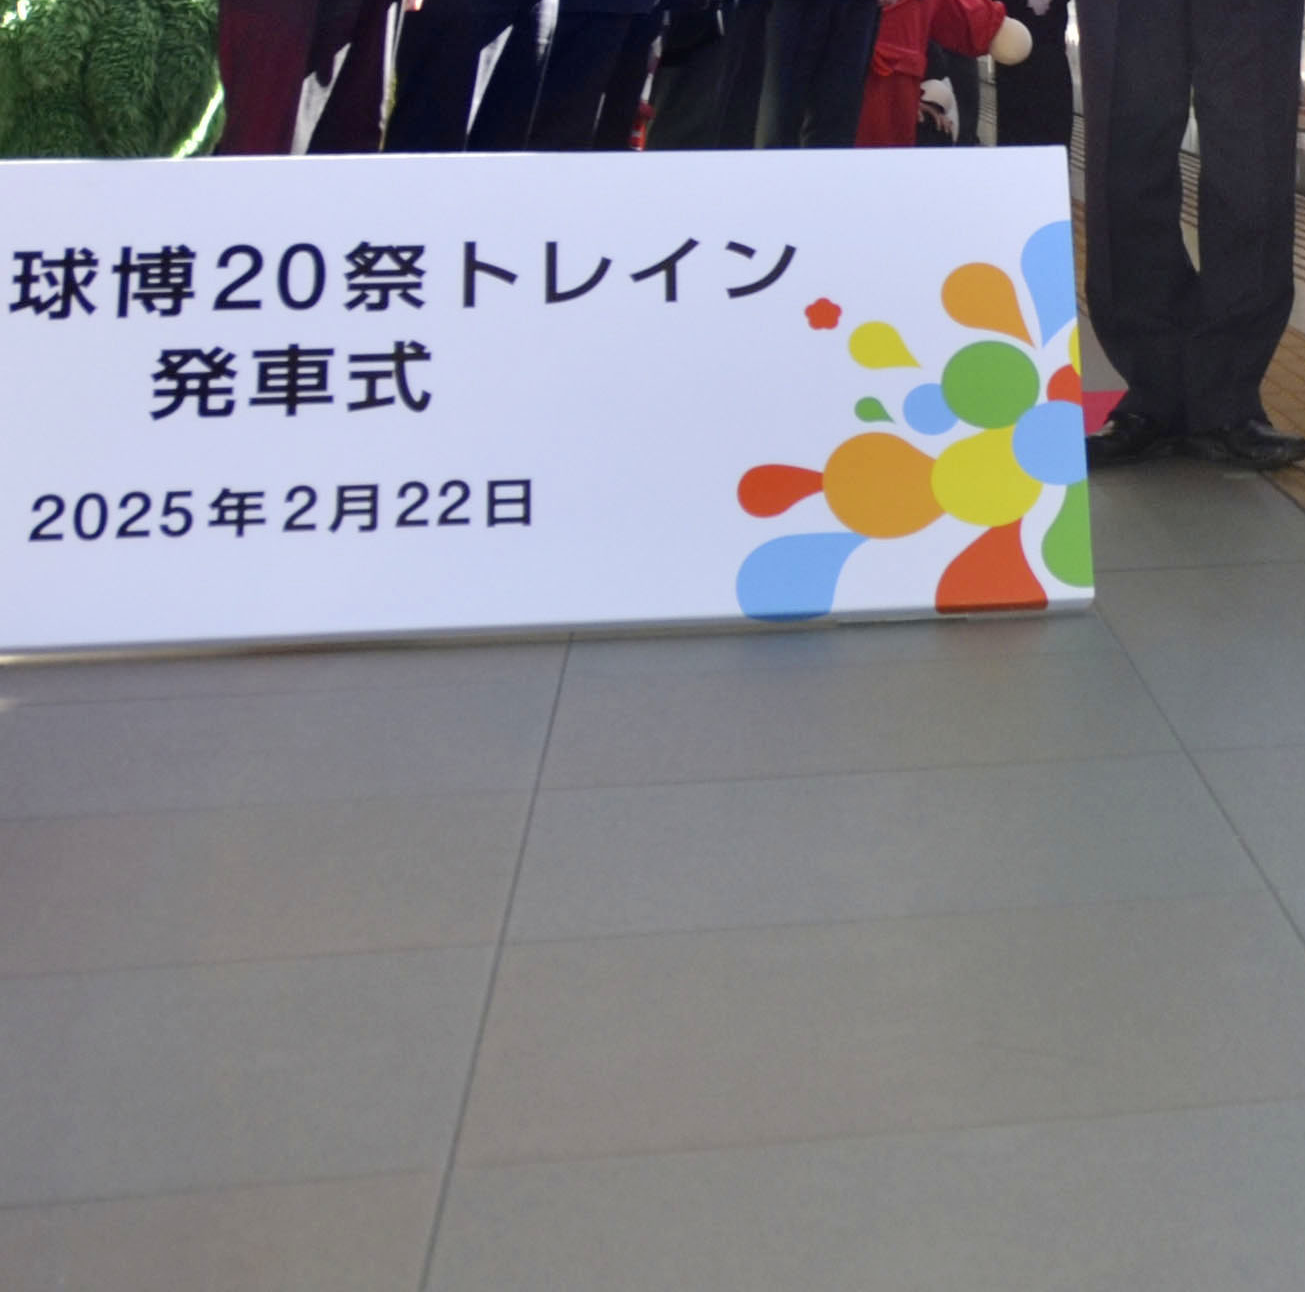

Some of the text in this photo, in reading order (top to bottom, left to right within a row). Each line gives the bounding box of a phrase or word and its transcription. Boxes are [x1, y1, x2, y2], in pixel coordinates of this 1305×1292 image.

[9, 237, 797, 320] 球博20祭トレイン
[150, 340, 432, 420] 発車式
[28, 478, 533, 542] 2025年2月22日
